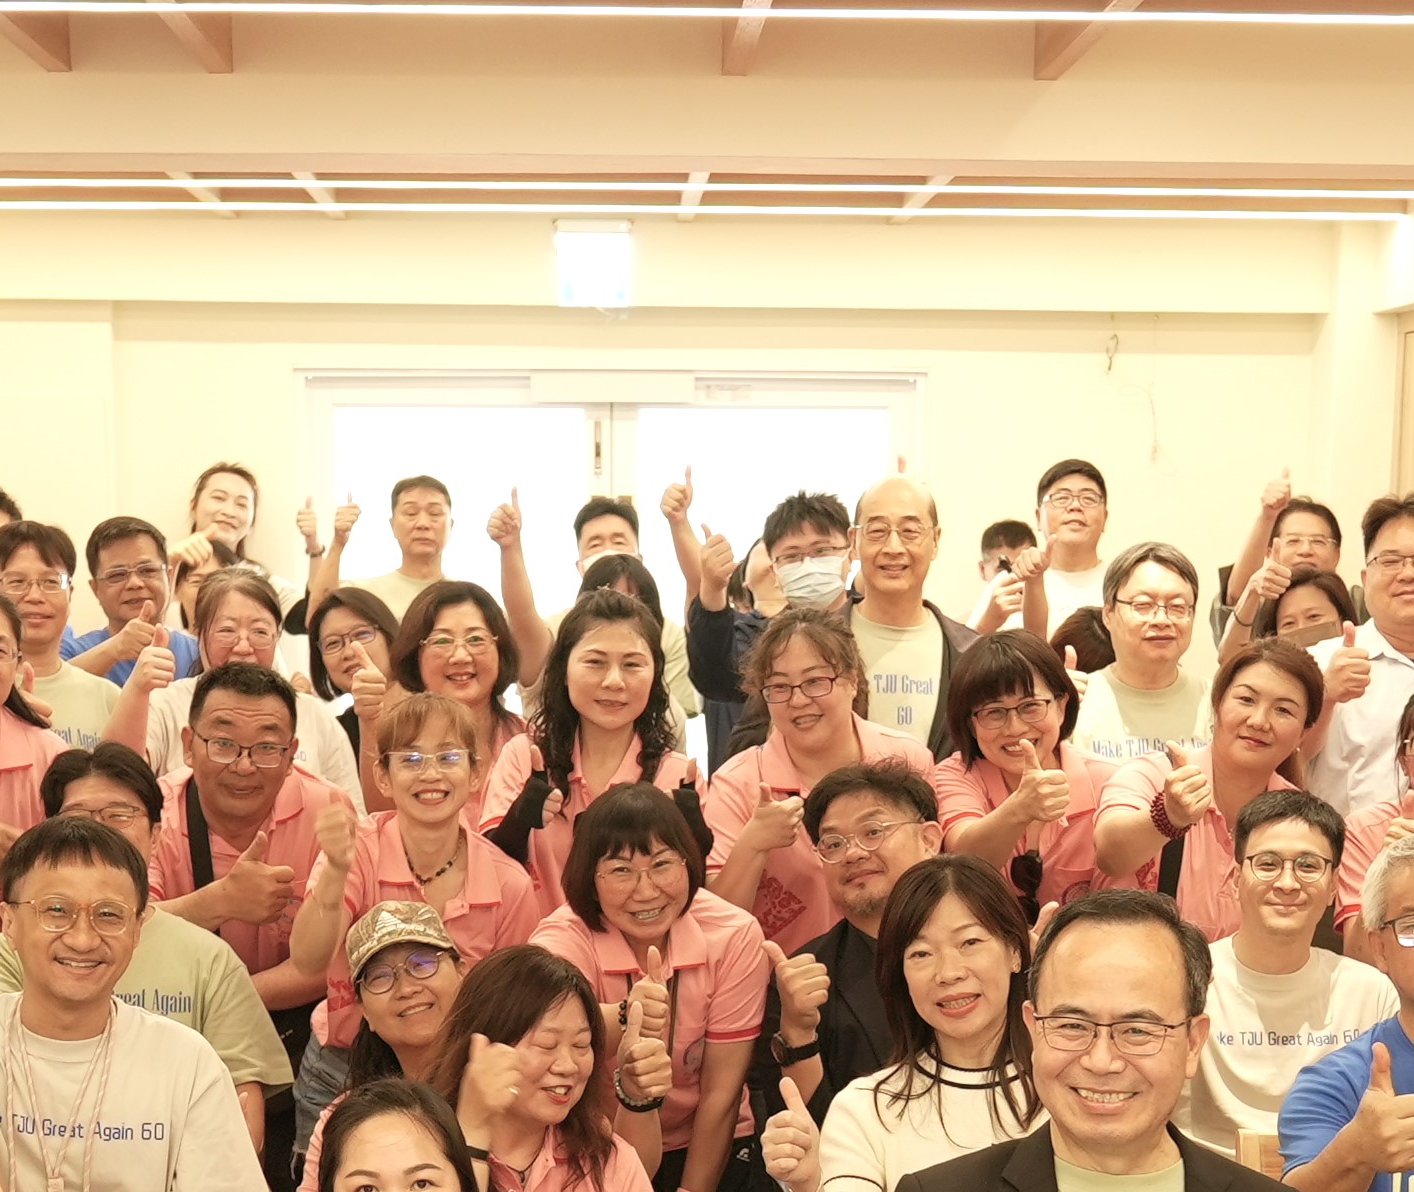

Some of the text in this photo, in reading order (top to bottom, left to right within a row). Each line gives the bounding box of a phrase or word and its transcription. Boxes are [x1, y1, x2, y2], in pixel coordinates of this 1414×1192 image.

[874, 674, 897, 694] TJU
[152, 988, 191, 1016] Again
[1240, 1032, 1263, 1046] TJU
[1268, 1031, 1302, 1046] Great
[1307, 1030, 1338, 1047] Again
[141, 1122, 165, 1141] 60
